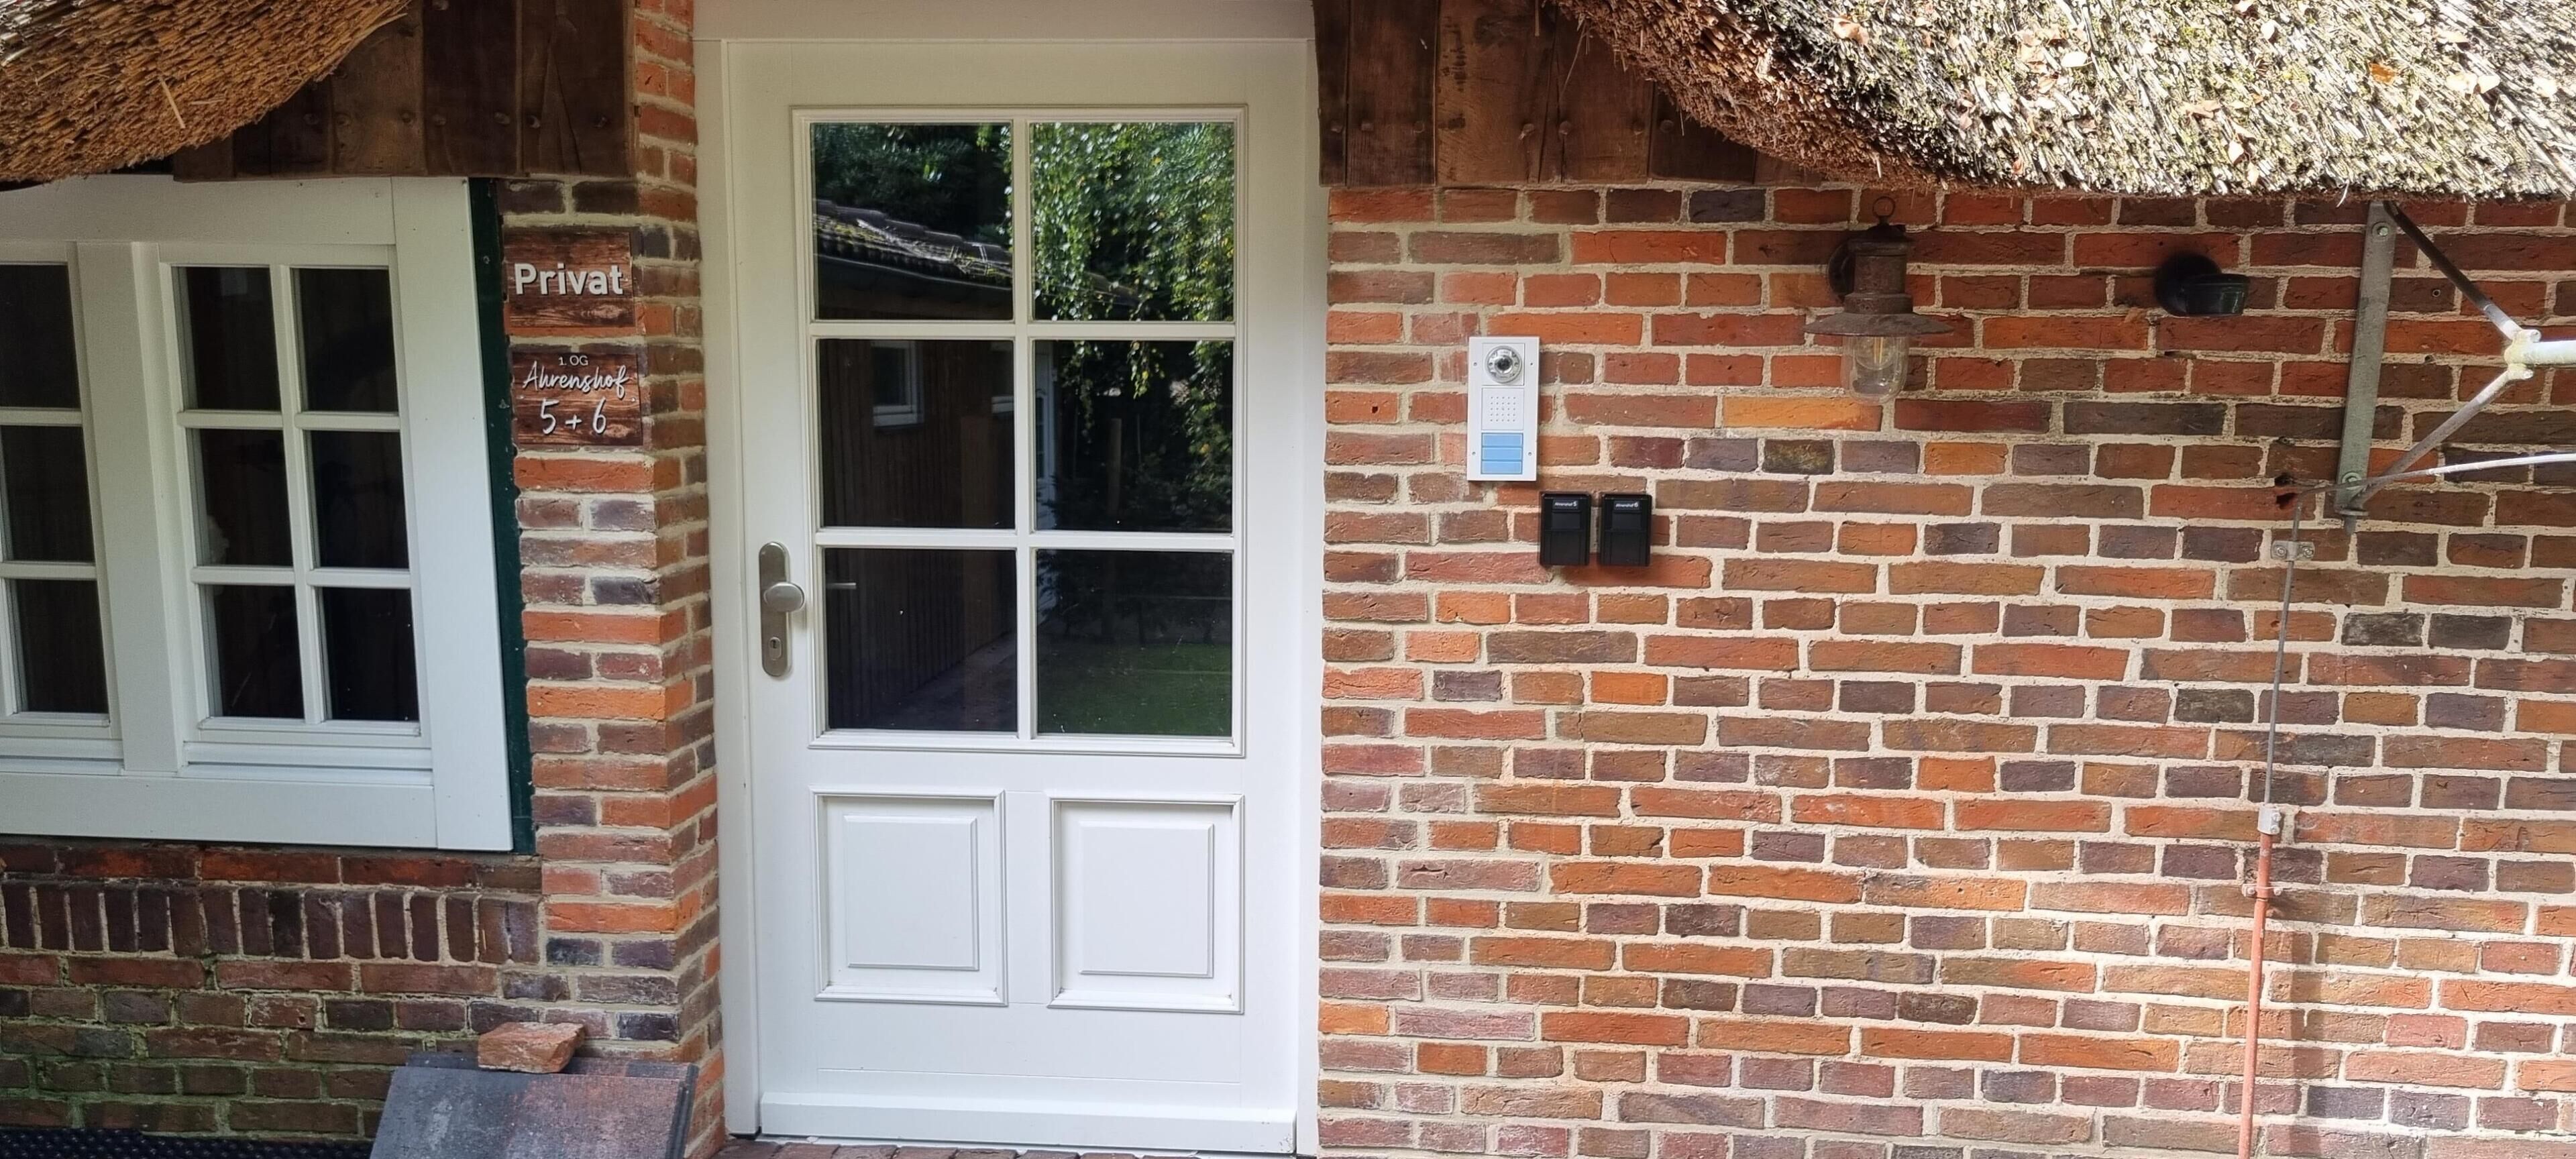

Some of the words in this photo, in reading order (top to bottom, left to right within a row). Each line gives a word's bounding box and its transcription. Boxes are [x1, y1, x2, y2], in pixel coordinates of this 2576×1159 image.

[515, 262, 623, 294] Privat
[569, 355, 589, 366] OG
[523, 361, 629, 399] Ahrenshof
[540, 398, 559, 435] 5
[565, 415, 582, 431] +
[592, 396, 607, 435] 6
